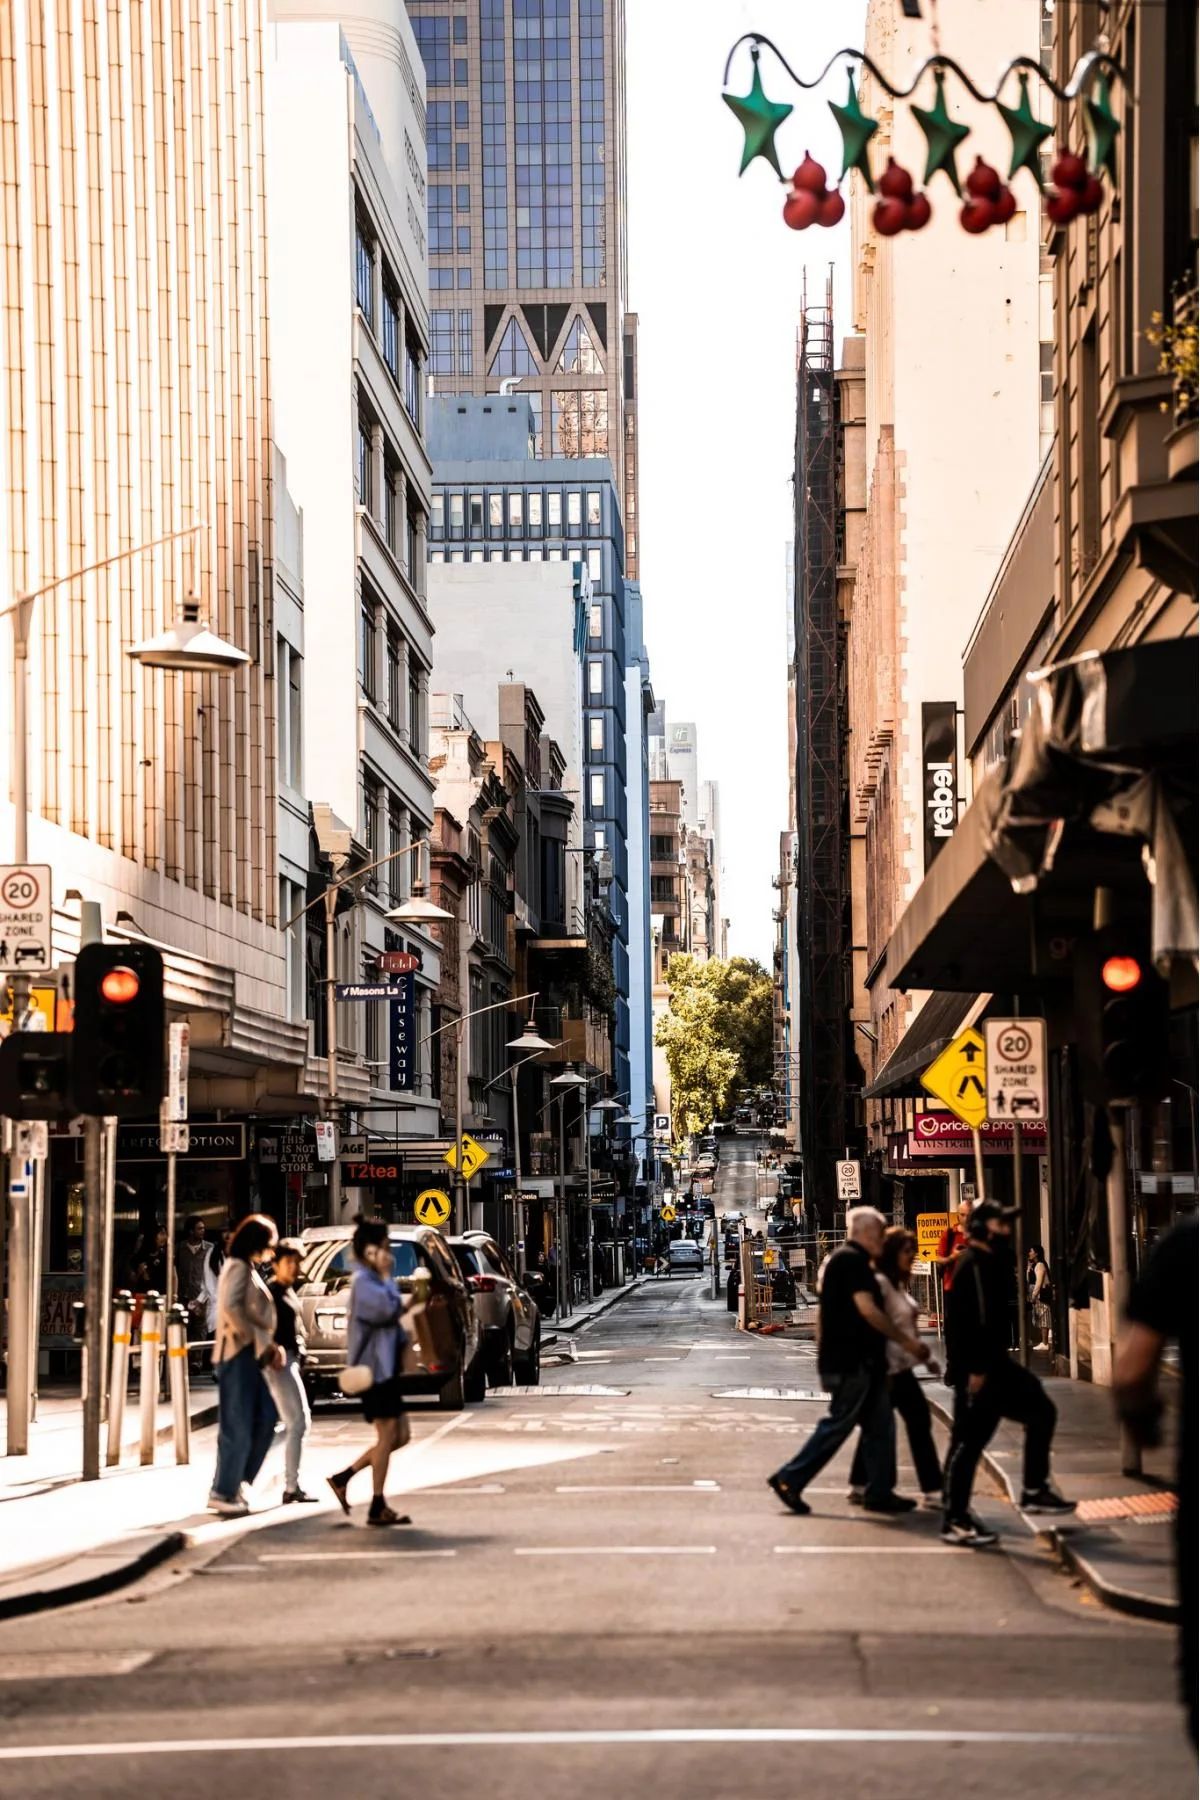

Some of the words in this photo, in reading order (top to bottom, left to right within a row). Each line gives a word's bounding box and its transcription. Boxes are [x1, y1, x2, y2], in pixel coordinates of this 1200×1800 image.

[927, 762, 953, 837] rebel
[9, 882, 32, 899] 20
[5, 926, 34, 936] ZONE
[380, 956, 412, 969] Hotel
[350, 987, 385, 996] Masons
[386, 986, 398, 995] La
[1004, 1036, 1027, 1052] 20
[994, 1065, 1037, 1075] SHARED
[1002, 1077, 1028, 1087] ZONE
[940, 1120, 990, 1133] pricee
[189, 1135, 235, 1147] OTION
[281, 1135, 305, 1144] THIS
[282, 1144, 292, 1153] IS
[295, 1144, 316, 1153] NOT
[280, 1153, 287, 1162] A
[290, 1153, 310, 1162] TOY
[280, 1163, 314, 1172] STORE
[347, 1163, 398, 1178] T2tea
[918, 1219, 948, 1227] FOOTPATH
